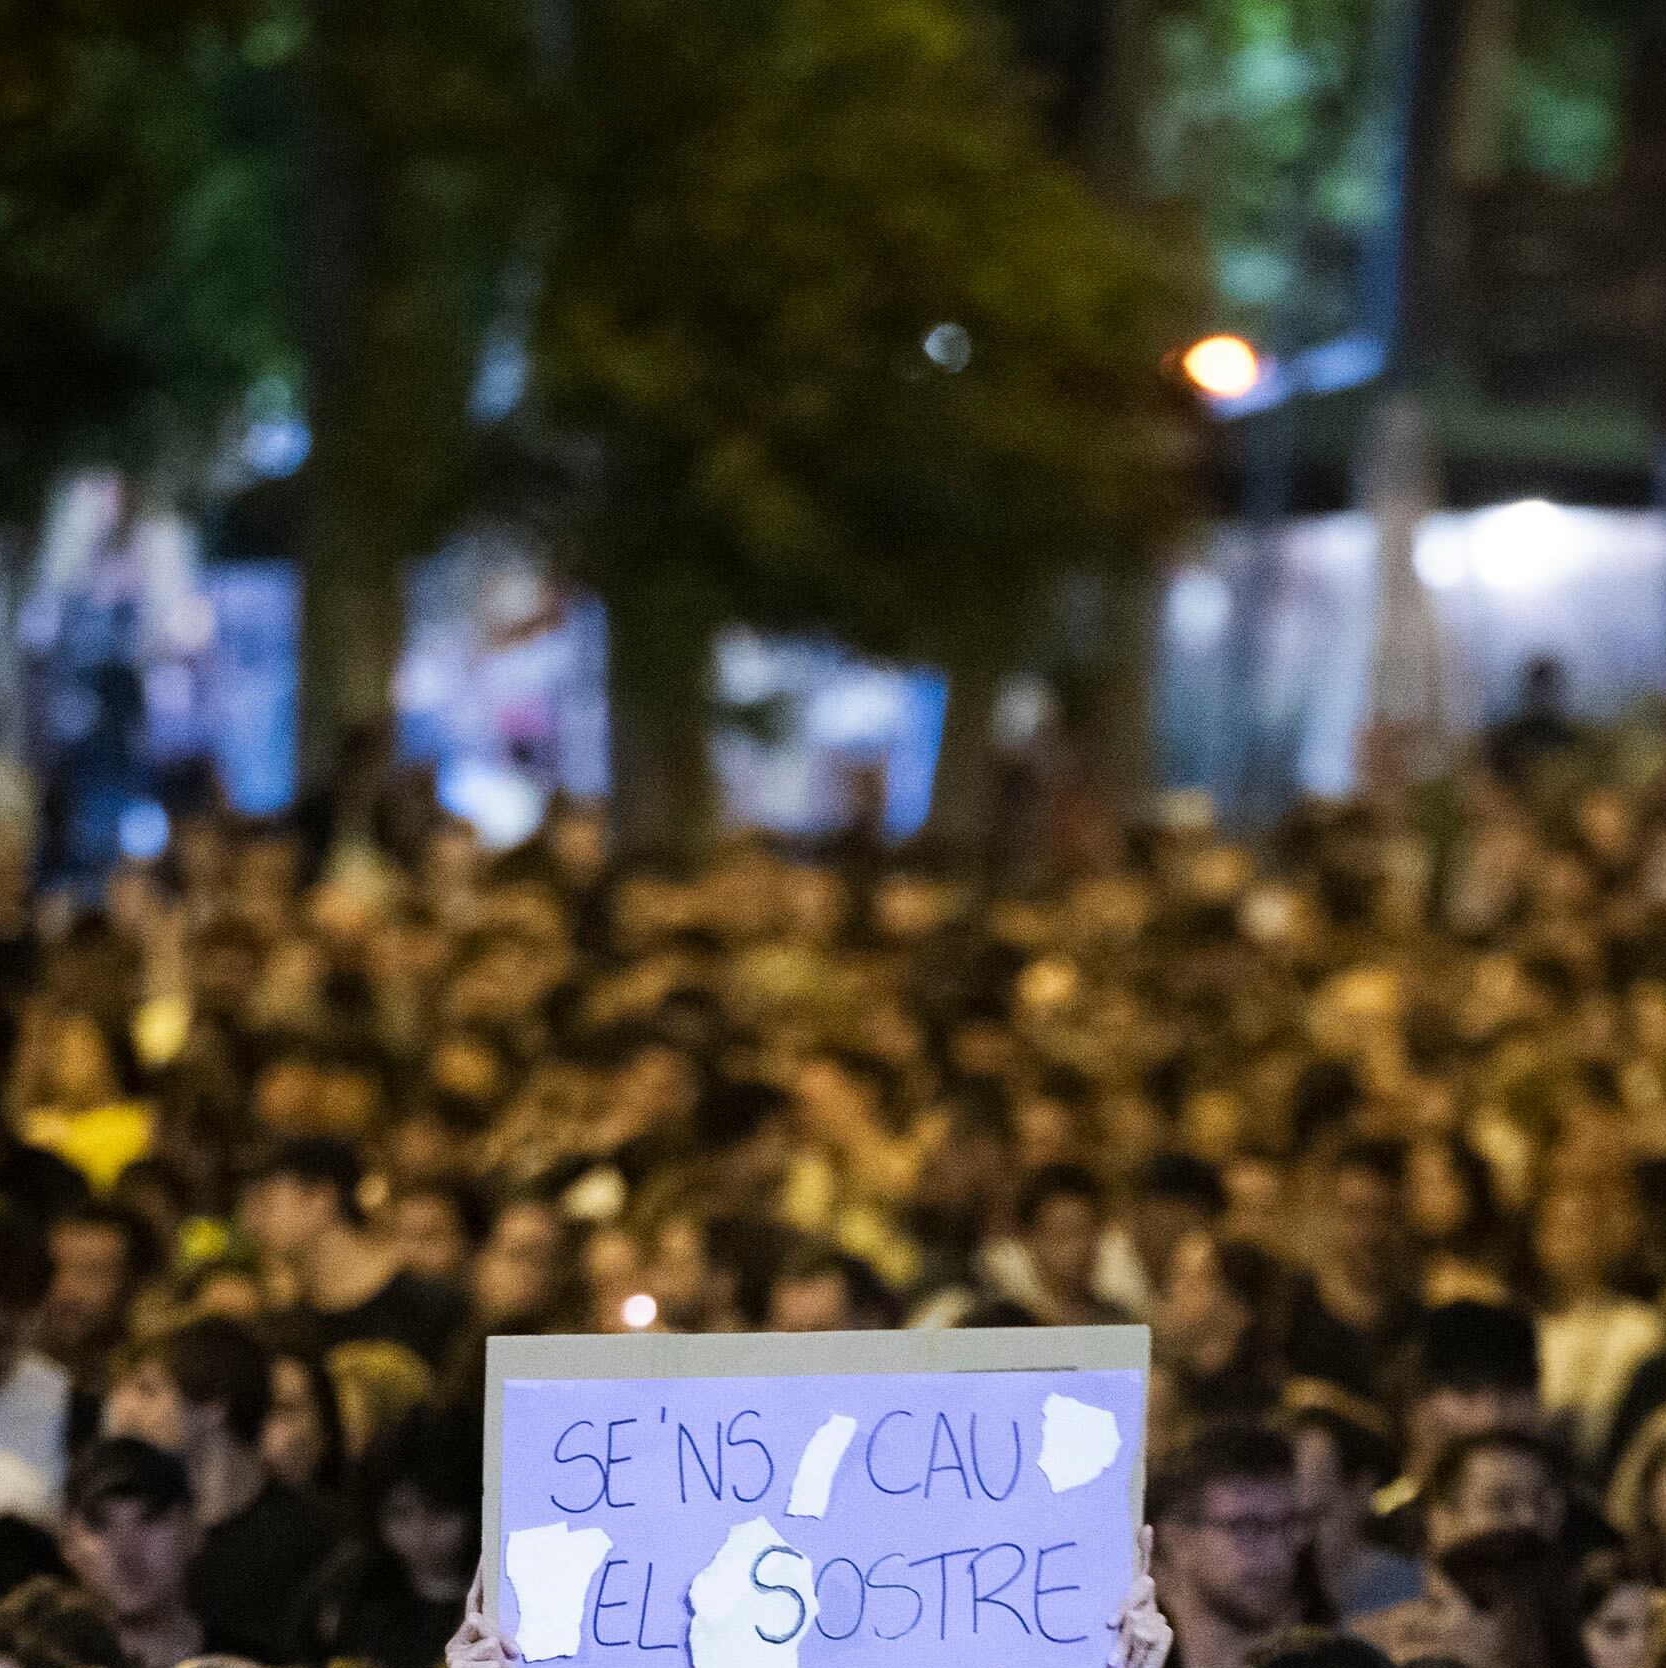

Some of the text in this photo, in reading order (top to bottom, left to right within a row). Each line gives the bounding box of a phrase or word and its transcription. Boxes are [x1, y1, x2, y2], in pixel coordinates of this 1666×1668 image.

[549, 1405, 1022, 1514] SE'NS CAU
[593, 1541, 1090, 1652] EL SOSTRE
